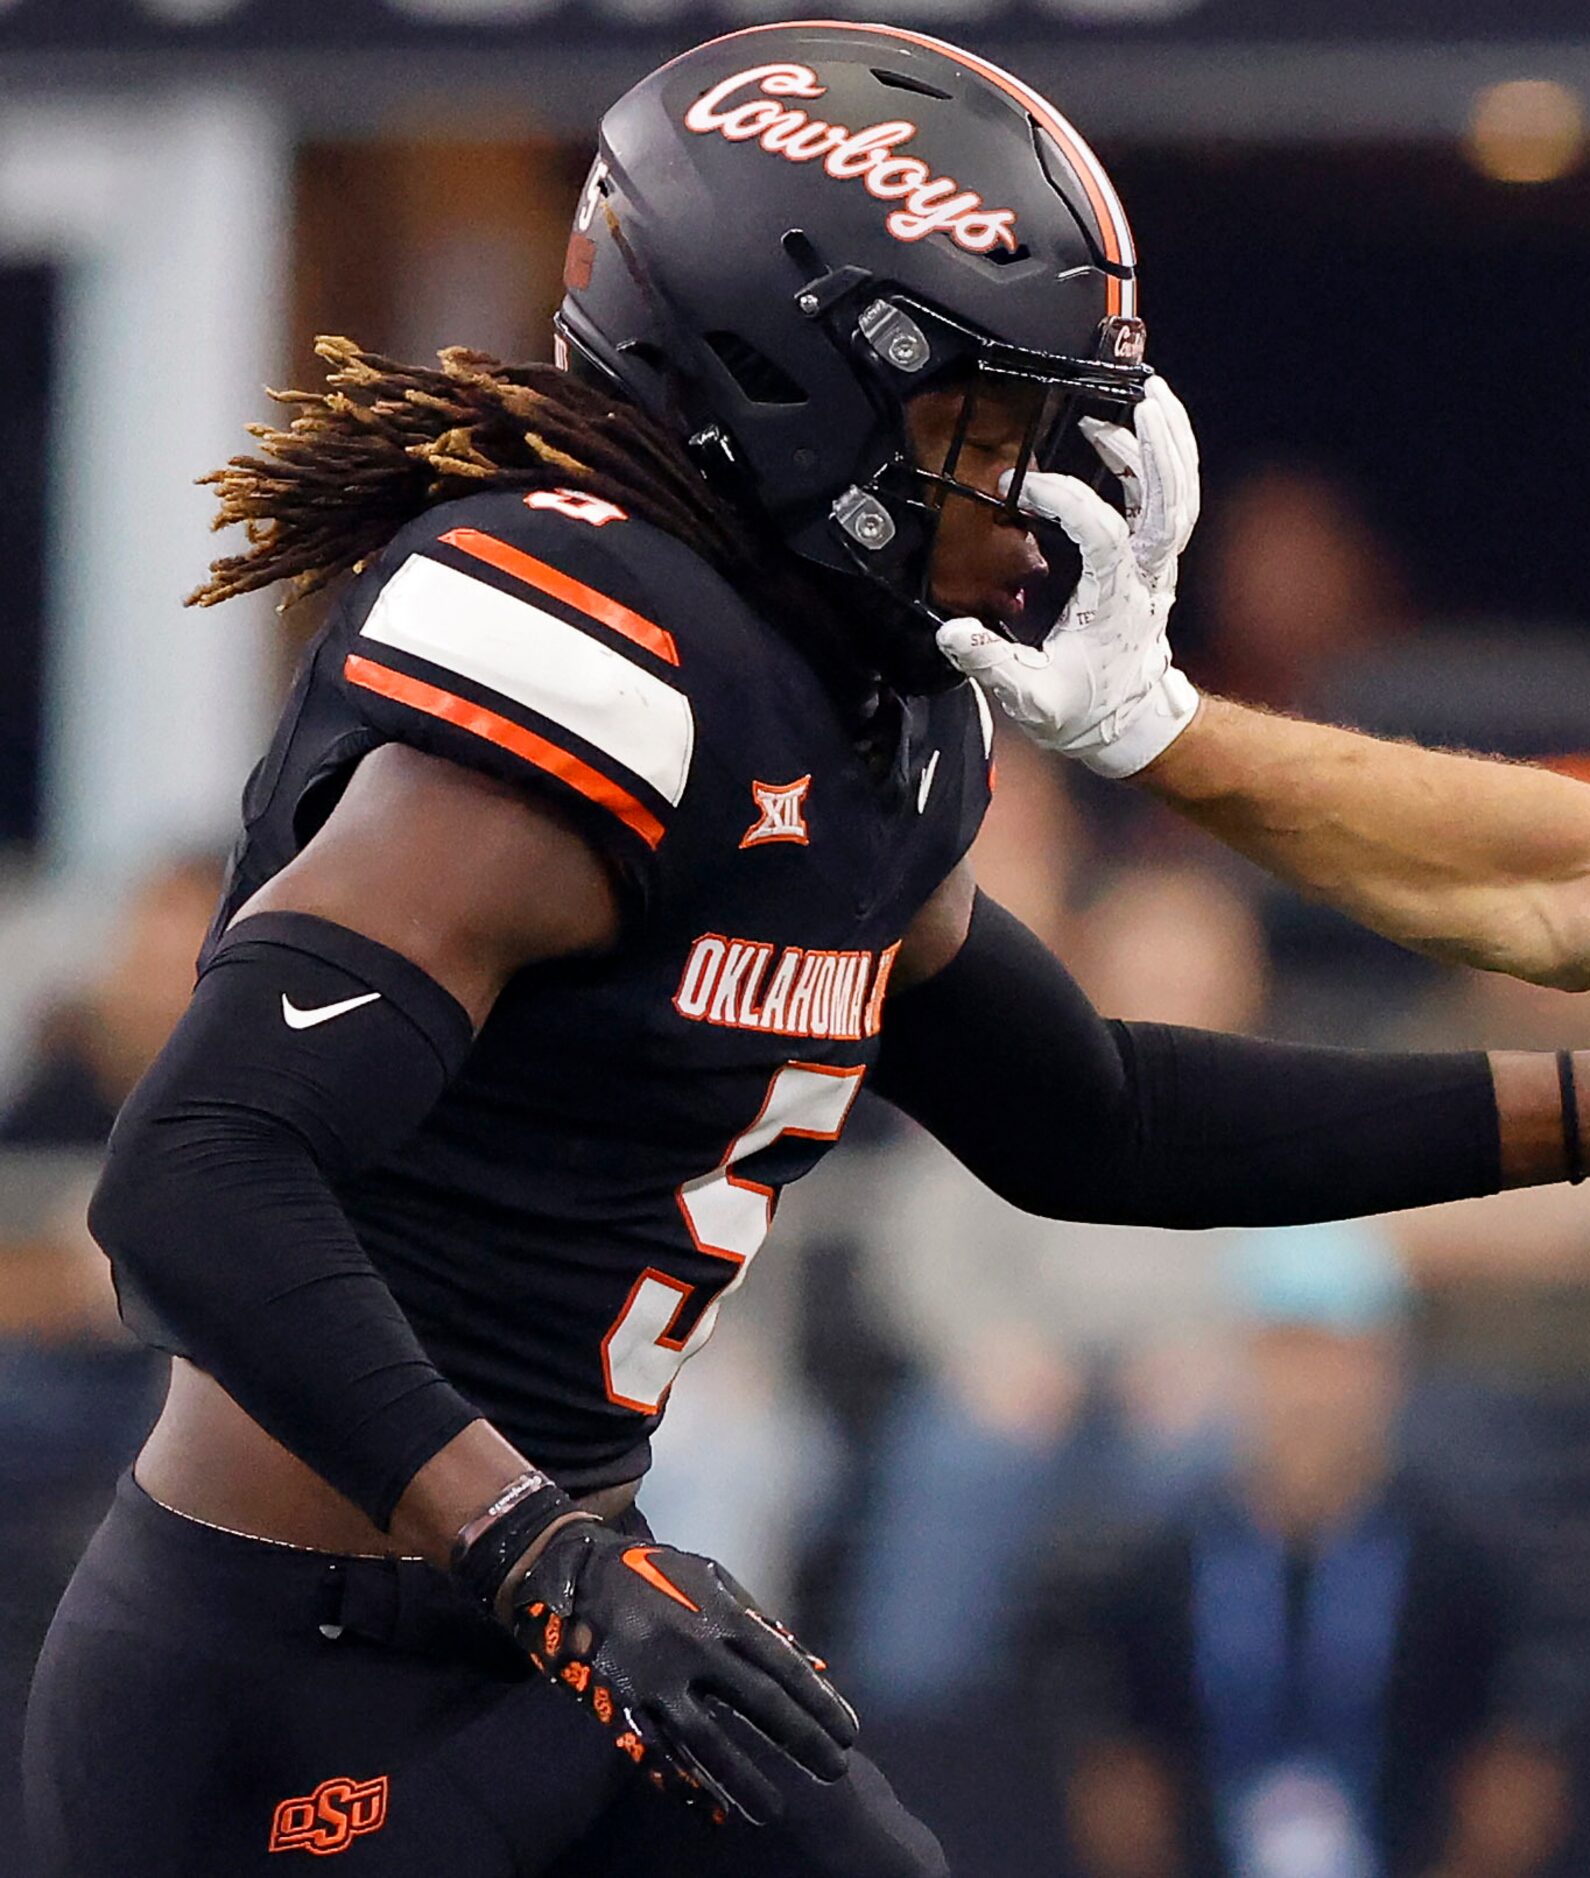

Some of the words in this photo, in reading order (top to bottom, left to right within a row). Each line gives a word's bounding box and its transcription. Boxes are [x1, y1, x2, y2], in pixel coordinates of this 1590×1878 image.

[684, 61, 1016, 255] Cowboys
[672, 932, 872, 1040] OKLAHOMA
[601, 1060, 866, 1414] 5
[273, 1779, 386, 1852] OSU
